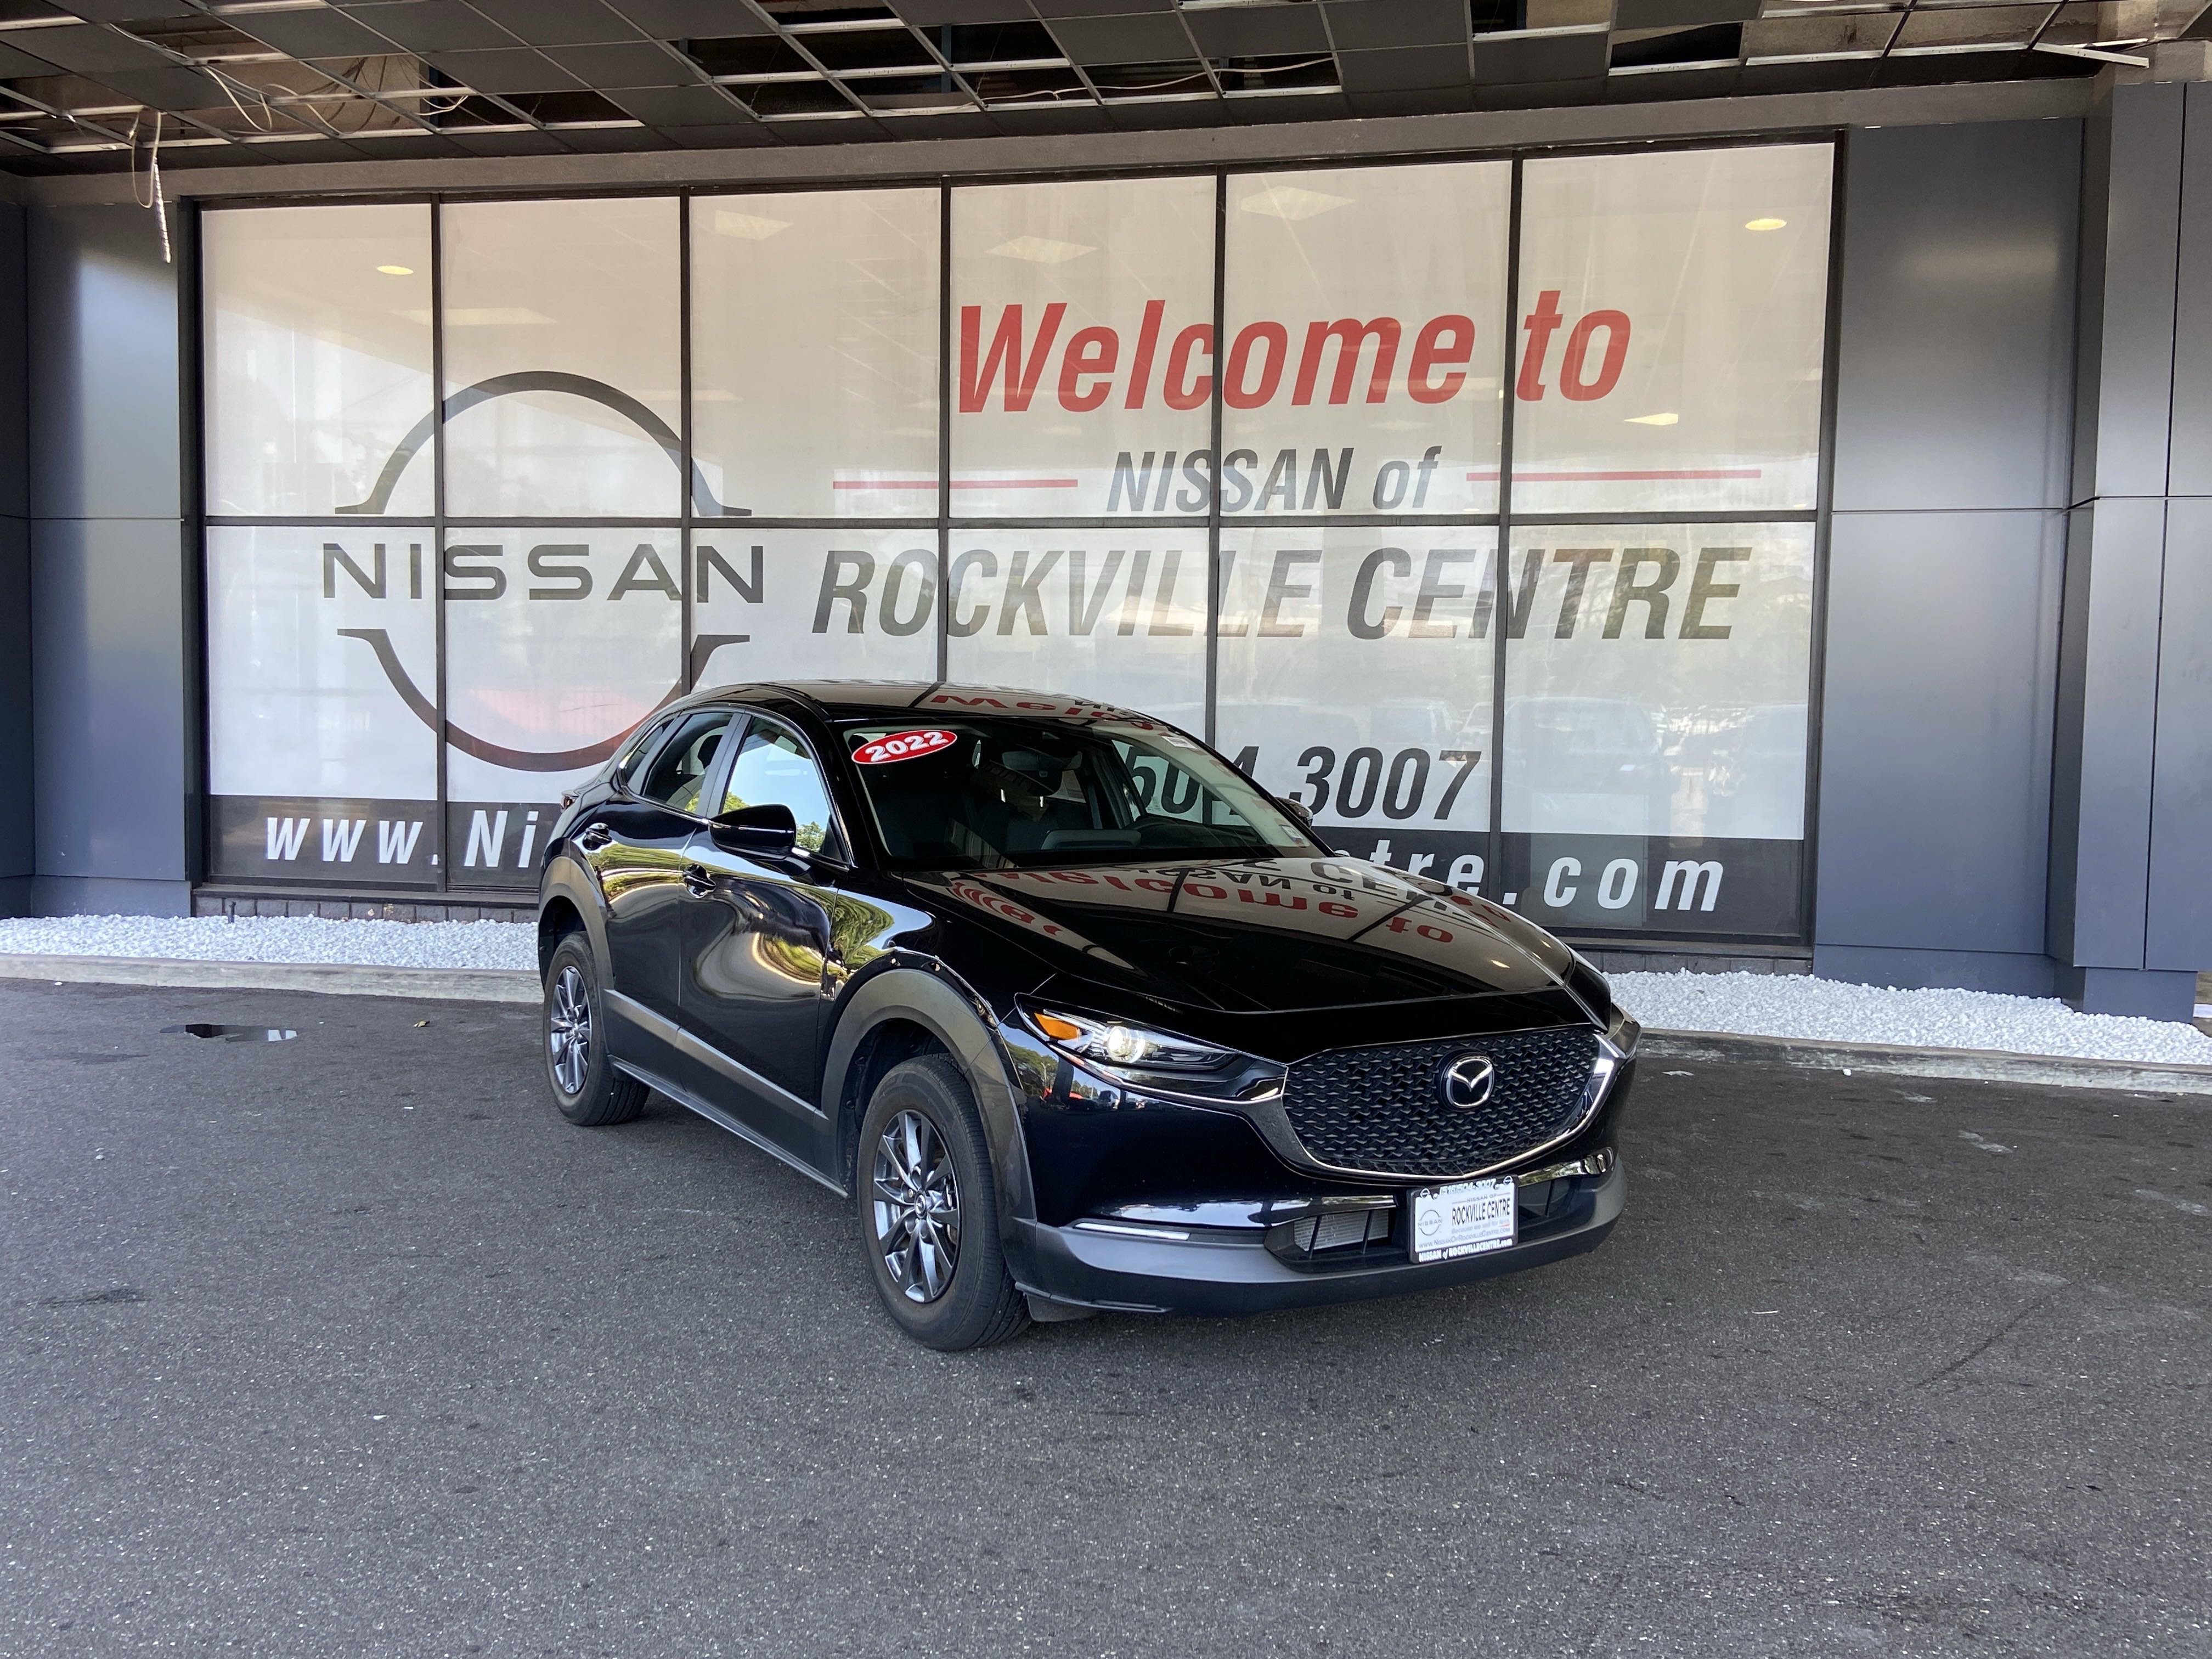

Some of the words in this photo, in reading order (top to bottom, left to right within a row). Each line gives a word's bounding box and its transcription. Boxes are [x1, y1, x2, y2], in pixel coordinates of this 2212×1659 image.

[960, 300, 1476, 413] Welcome
[1516, 289, 1632, 402] to
[1106, 447, 1354, 512] NISSAN
[1372, 445, 1442, 510] of
[323, 543, 764, 603] NISSAN
[812, 549, 1322, 637] ROCKVILLE
[1347, 546, 1753, 639] CENTRE
[865, 731, 949, 762] 2022
[1289, 746, 1482, 820] 3007
[1334, 839, 1724, 912] tre.com
[1417, 1218, 1443, 1227] NISSAN
[1452, 1202, 1486, 1226] ROCKVILLE
[1487, 1198, 1510, 1219] CENTRE
[1419, 1250, 1442, 1262] NISSAN
